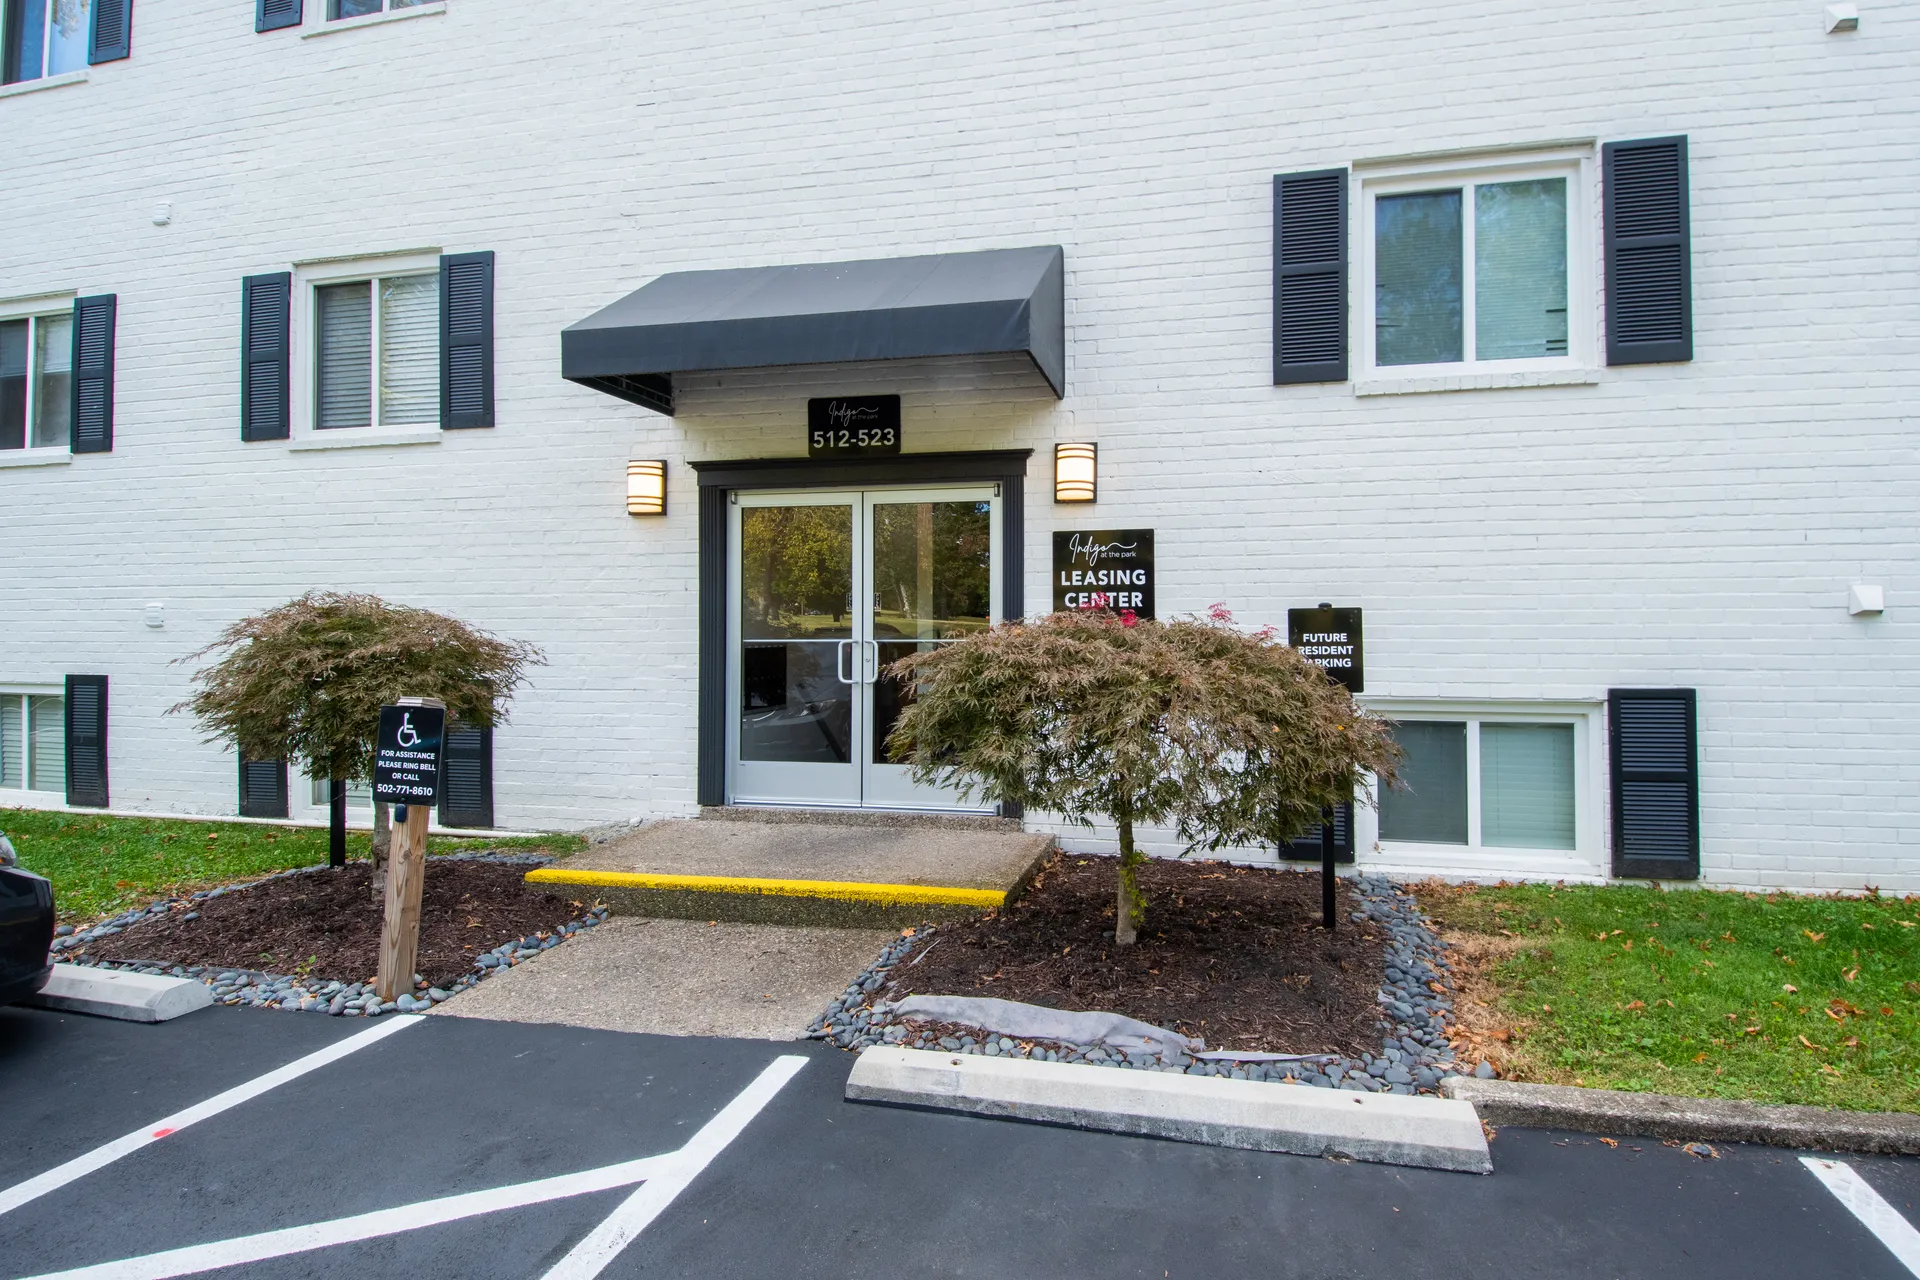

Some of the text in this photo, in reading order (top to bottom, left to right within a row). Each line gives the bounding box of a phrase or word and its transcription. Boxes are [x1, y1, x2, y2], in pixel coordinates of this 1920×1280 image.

[829, 401, 879, 427] Indigo
[813, 428, 895, 448] 512-523
[1069, 533, 1137, 567] Indigo
[1061, 569, 1146, 586] LEASING
[1064, 591, 1143, 608] CENTER
[1303, 633, 1347, 642] FUTURE
[1298, 645, 1354, 655] RESIDENT
[395, 750, 436, 760] ASSISTANCE
[378, 760, 436, 771] PLEASE RING BELL
[402, 773, 420, 781] CALL
[377, 783, 433, 796] 502-771-8610
